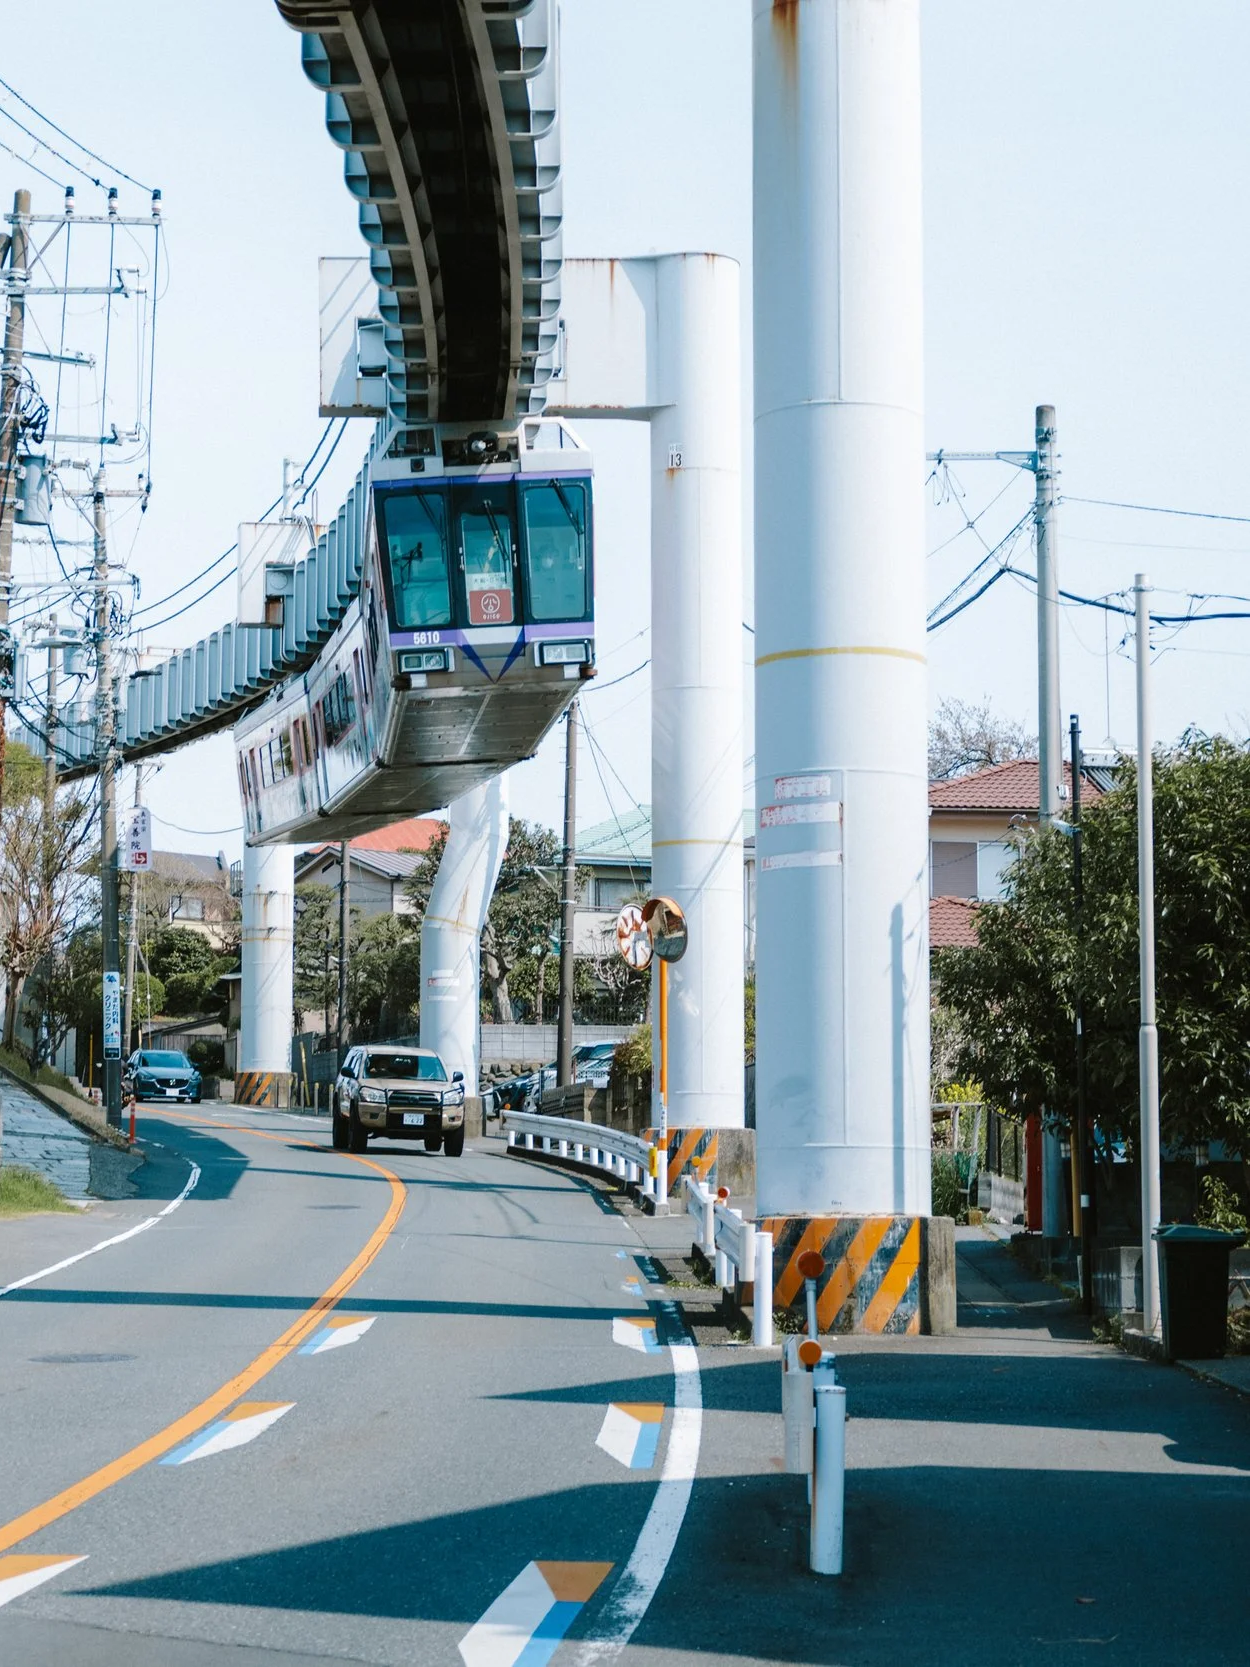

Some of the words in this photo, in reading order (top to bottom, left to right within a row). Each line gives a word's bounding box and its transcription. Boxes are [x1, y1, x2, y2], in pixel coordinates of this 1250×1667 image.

[670, 453, 682, 467] 13
[104, 994, 112, 1030] クリニック
